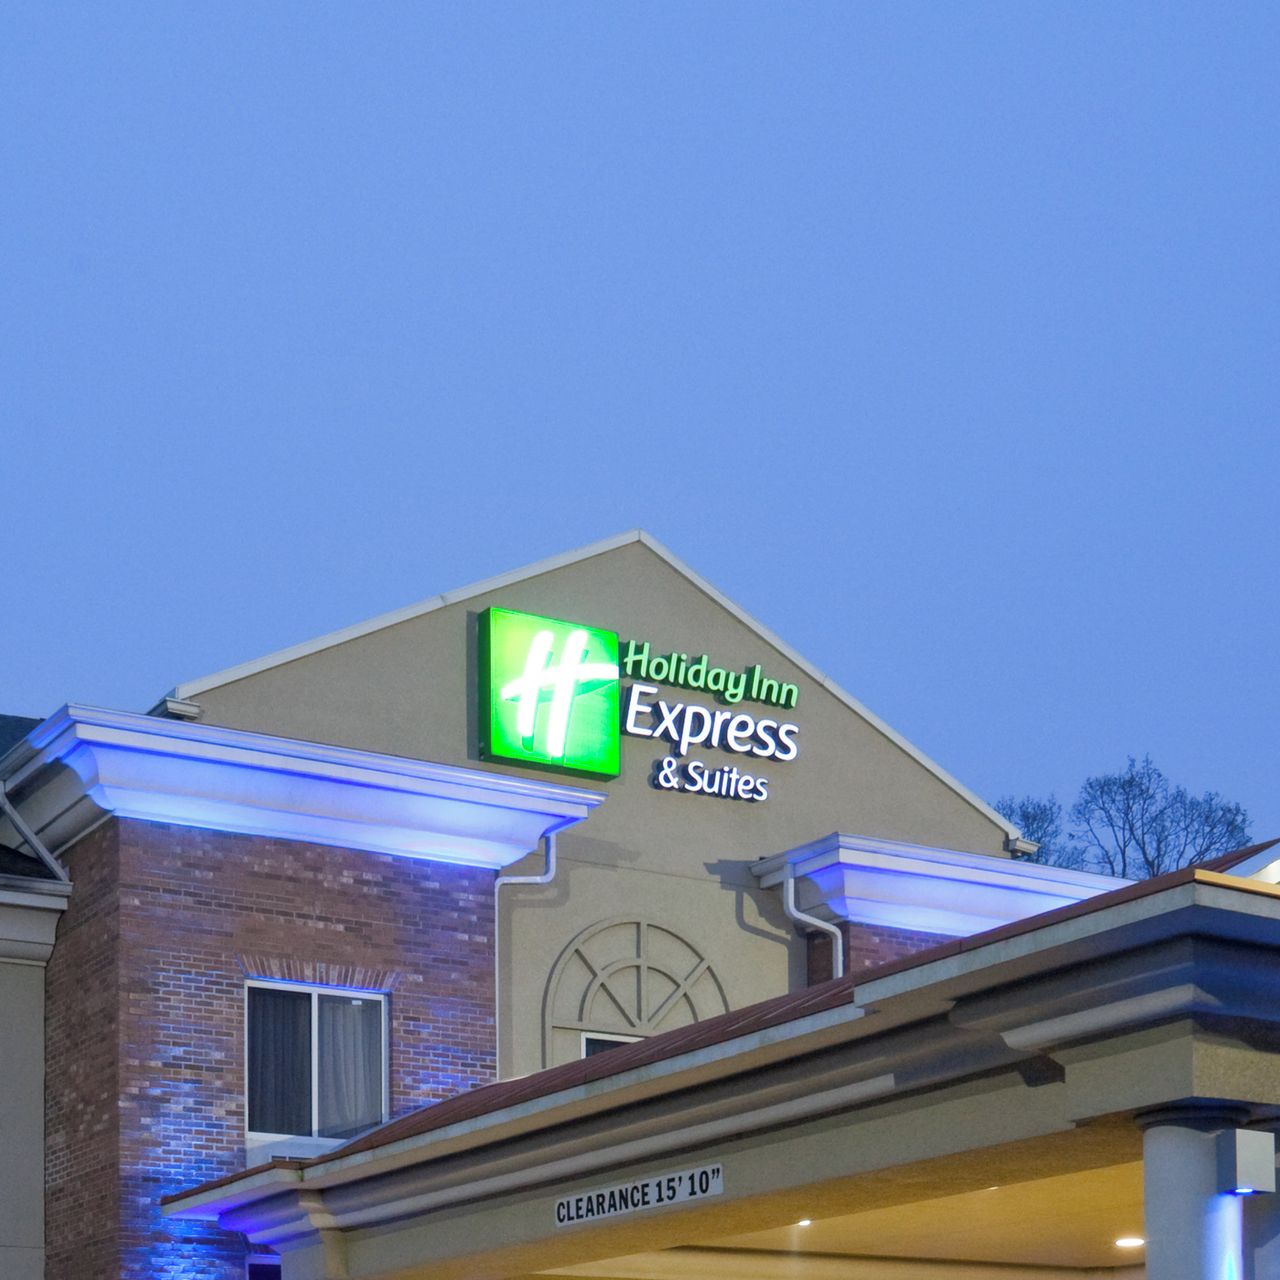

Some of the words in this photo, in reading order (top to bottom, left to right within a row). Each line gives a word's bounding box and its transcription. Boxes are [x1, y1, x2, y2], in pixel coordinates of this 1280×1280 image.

[624, 640, 747, 703] Holiday
[751, 664, 799, 708] Inn
[626, 683, 800, 761] Express
[658, 757, 679, 789] &
[684, 761, 769, 801] Suites
[557, 1183, 650, 1223] CLEARANCE
